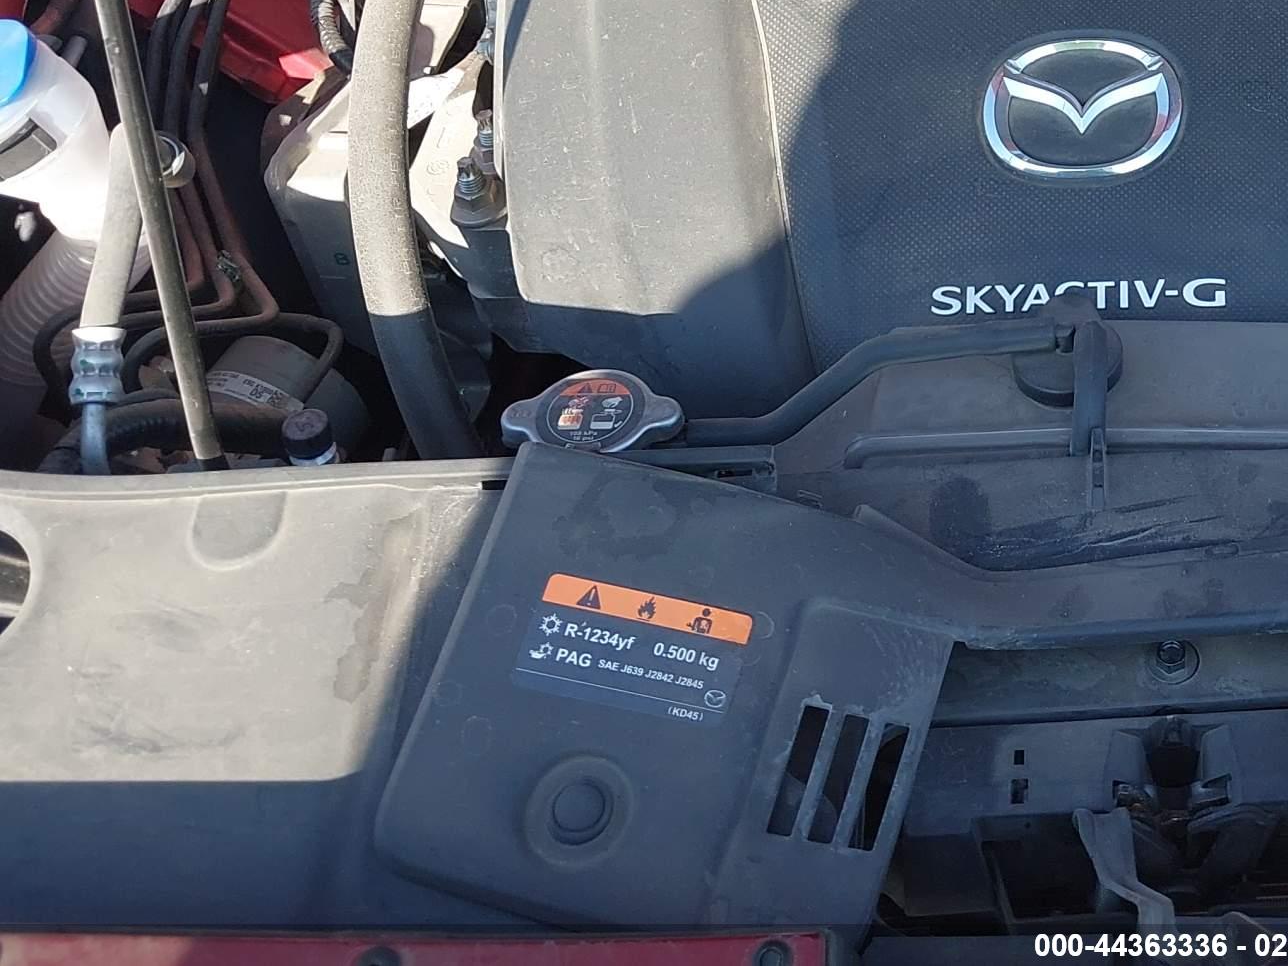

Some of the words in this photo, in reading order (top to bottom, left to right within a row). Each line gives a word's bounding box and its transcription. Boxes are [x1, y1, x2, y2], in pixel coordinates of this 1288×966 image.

[555, 647, 592, 668] PAG
[597, 658, 619, 672] SAE
[620, 665, 644, 678] J639
[645, 669, 674, 684] J2842
[675, 675, 704, 689] J2845
[564, 622, 636, 651] R-1234yf
[653, 642, 696, 664] 0.500
[699, 654, 719, 672] kg
[668, 706, 704, 721] (KD45)
